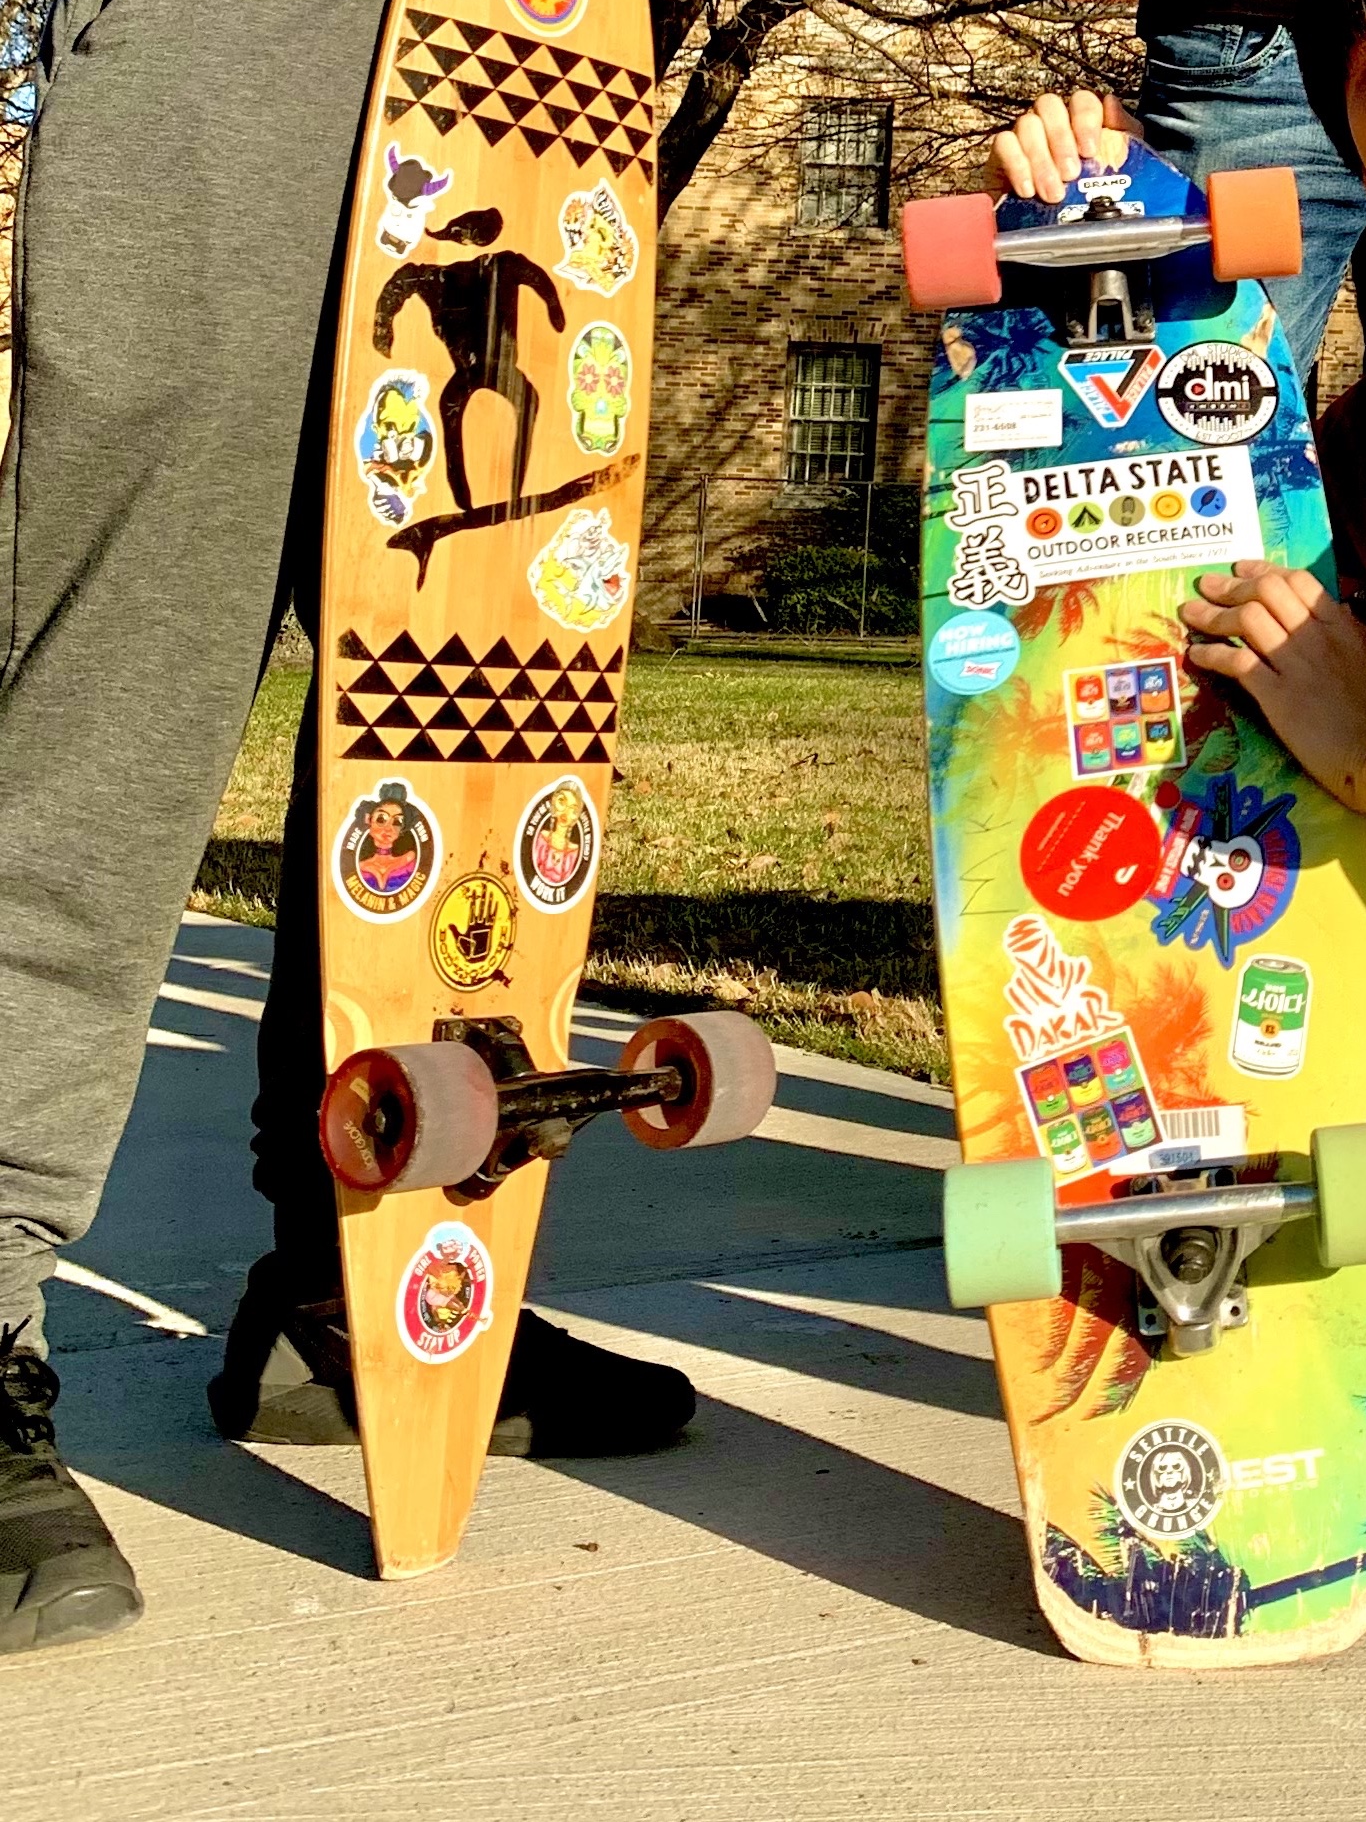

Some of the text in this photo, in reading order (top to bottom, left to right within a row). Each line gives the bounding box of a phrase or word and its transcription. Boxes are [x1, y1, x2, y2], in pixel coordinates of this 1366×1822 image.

[1083, 178, 1127, 189] BRAND
[1085, 348, 1134, 362] PALACE
[1206, 343, 1257, 365] STUDIOS
[1123, 363, 1154, 404] PALACE
[1184, 366, 1251, 402] dmi
[1023, 454, 1224, 505] DELTA STATE
[950, 464, 1029, 606] 正義
[1027, 521, 1235, 561] OUTDOOR RECREATION
[939, 621, 988, 643] NOW
[944, 631, 1015, 657] HIRING
[345, 827, 363, 851] MADE
[1080, 811, 1126, 864] Thank
[345, 871, 427, 911] MELANIN & MAGIC
[530, 874, 566, 903] WORK IT
[1056, 858, 1088, 897] you
[1009, 989, 1118, 1057] DAKAR
[414, 1255, 433, 1277] GIRL
[416, 1328, 461, 1352] STAY UP
[1128, 1427, 1210, 1463] SEATTLE
[1133, 1497, 1214, 1532] GRUNGE
